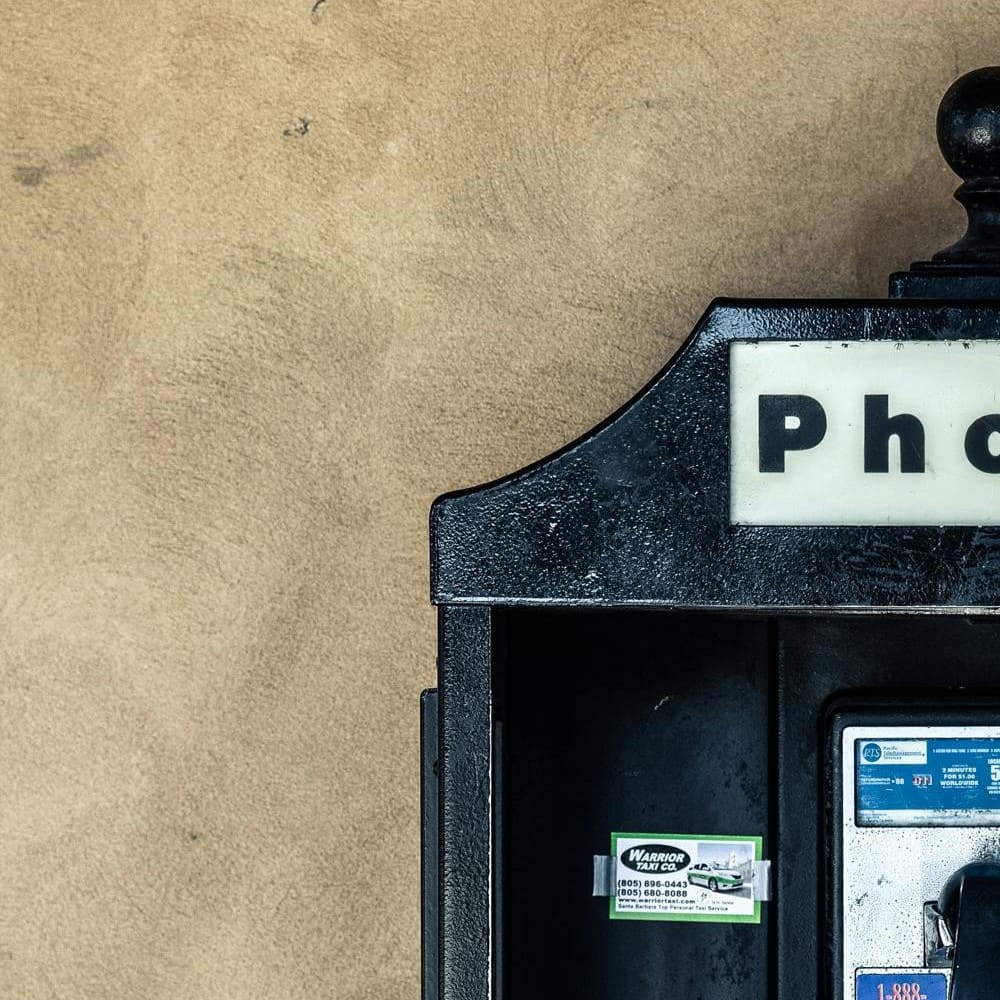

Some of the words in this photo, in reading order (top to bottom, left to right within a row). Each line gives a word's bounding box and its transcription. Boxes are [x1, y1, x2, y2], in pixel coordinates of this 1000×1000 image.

[628, 848, 686, 863] WARRIOR
[635, 862, 659, 871] TAXI
[660, 862, 678, 871] CO.
[617, 879, 642, 889] (805)
[643, 880, 688, 889] 896-0443
[617, 888, 642, 898] (805)
[643, 889, 688, 898] 680-8088
